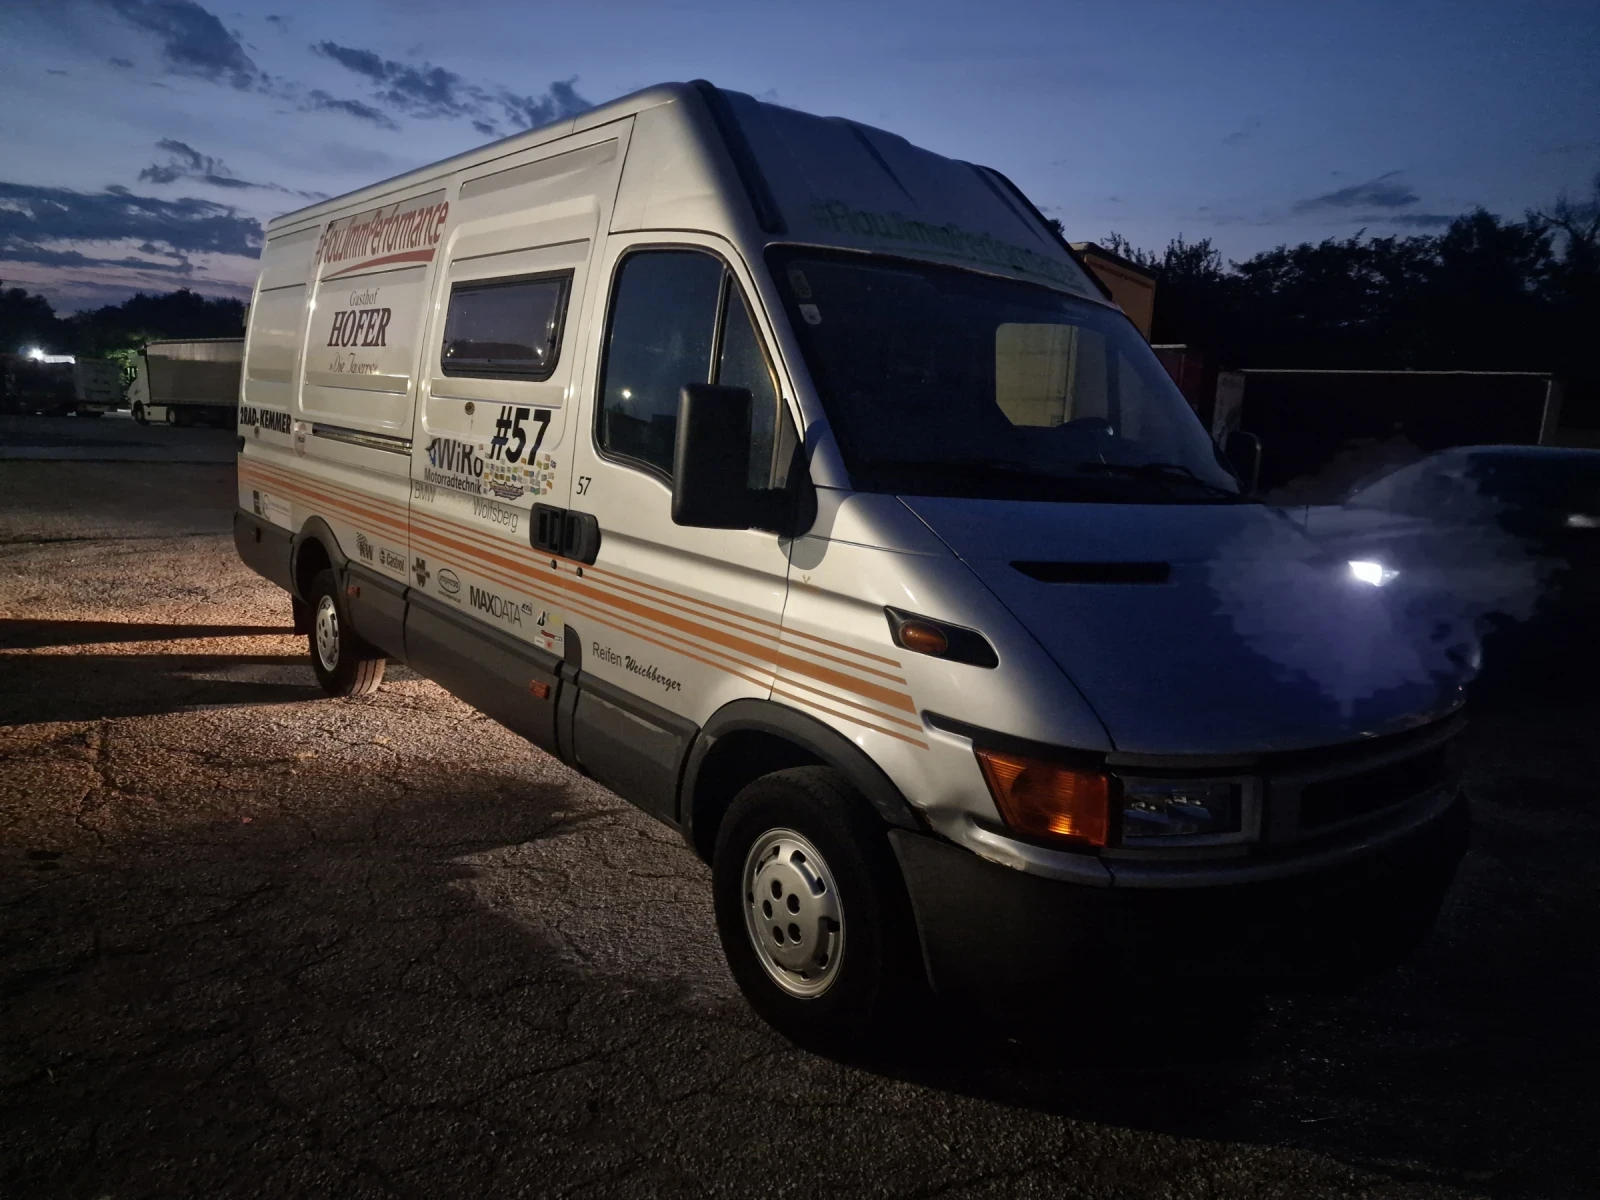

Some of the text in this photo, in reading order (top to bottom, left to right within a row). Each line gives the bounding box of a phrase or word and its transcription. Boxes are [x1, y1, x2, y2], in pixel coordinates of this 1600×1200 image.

[349, 287, 380, 307] Gasthof
[327, 307, 392, 348] HOFER
[489, 405, 552, 467] #57
[424, 468, 482, 495] Motorradtechnik
[576, 475, 592, 496] 57
[473, 495, 519, 533] Wolfsberg
[386, 552, 405, 573] Castrol
[469, 585, 523, 629] MAXDATA
[592, 641, 622, 668] Reifen
